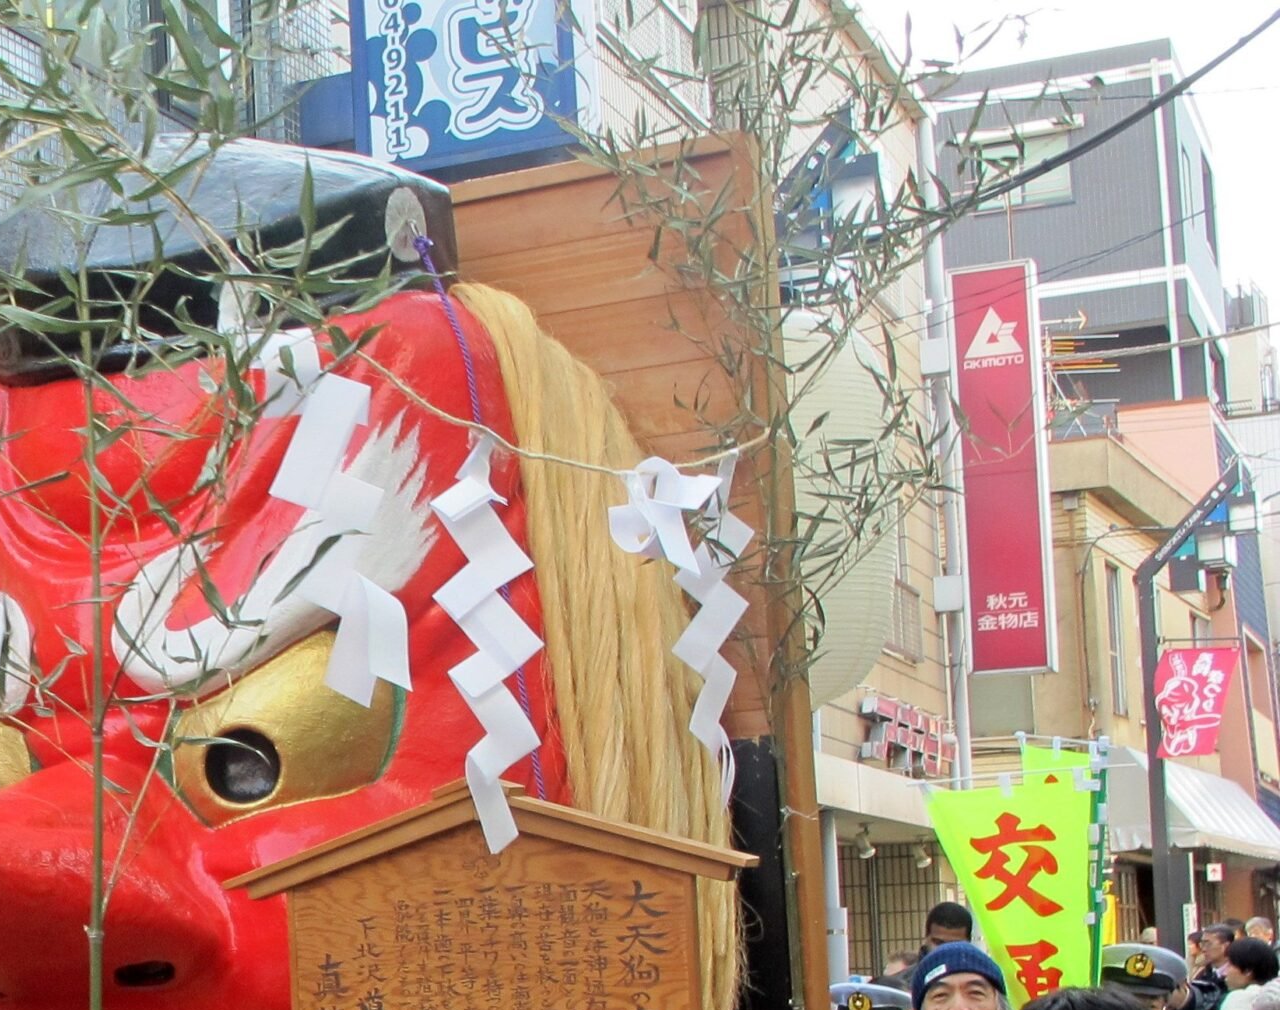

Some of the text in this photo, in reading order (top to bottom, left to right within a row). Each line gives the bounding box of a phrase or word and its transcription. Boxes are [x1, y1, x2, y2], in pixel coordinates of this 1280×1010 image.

[963, 354, 1025, 370] AKIMOTO
[986, 591, 1028, 611] 秋元
[977, 611, 1039, 631] 金物店
